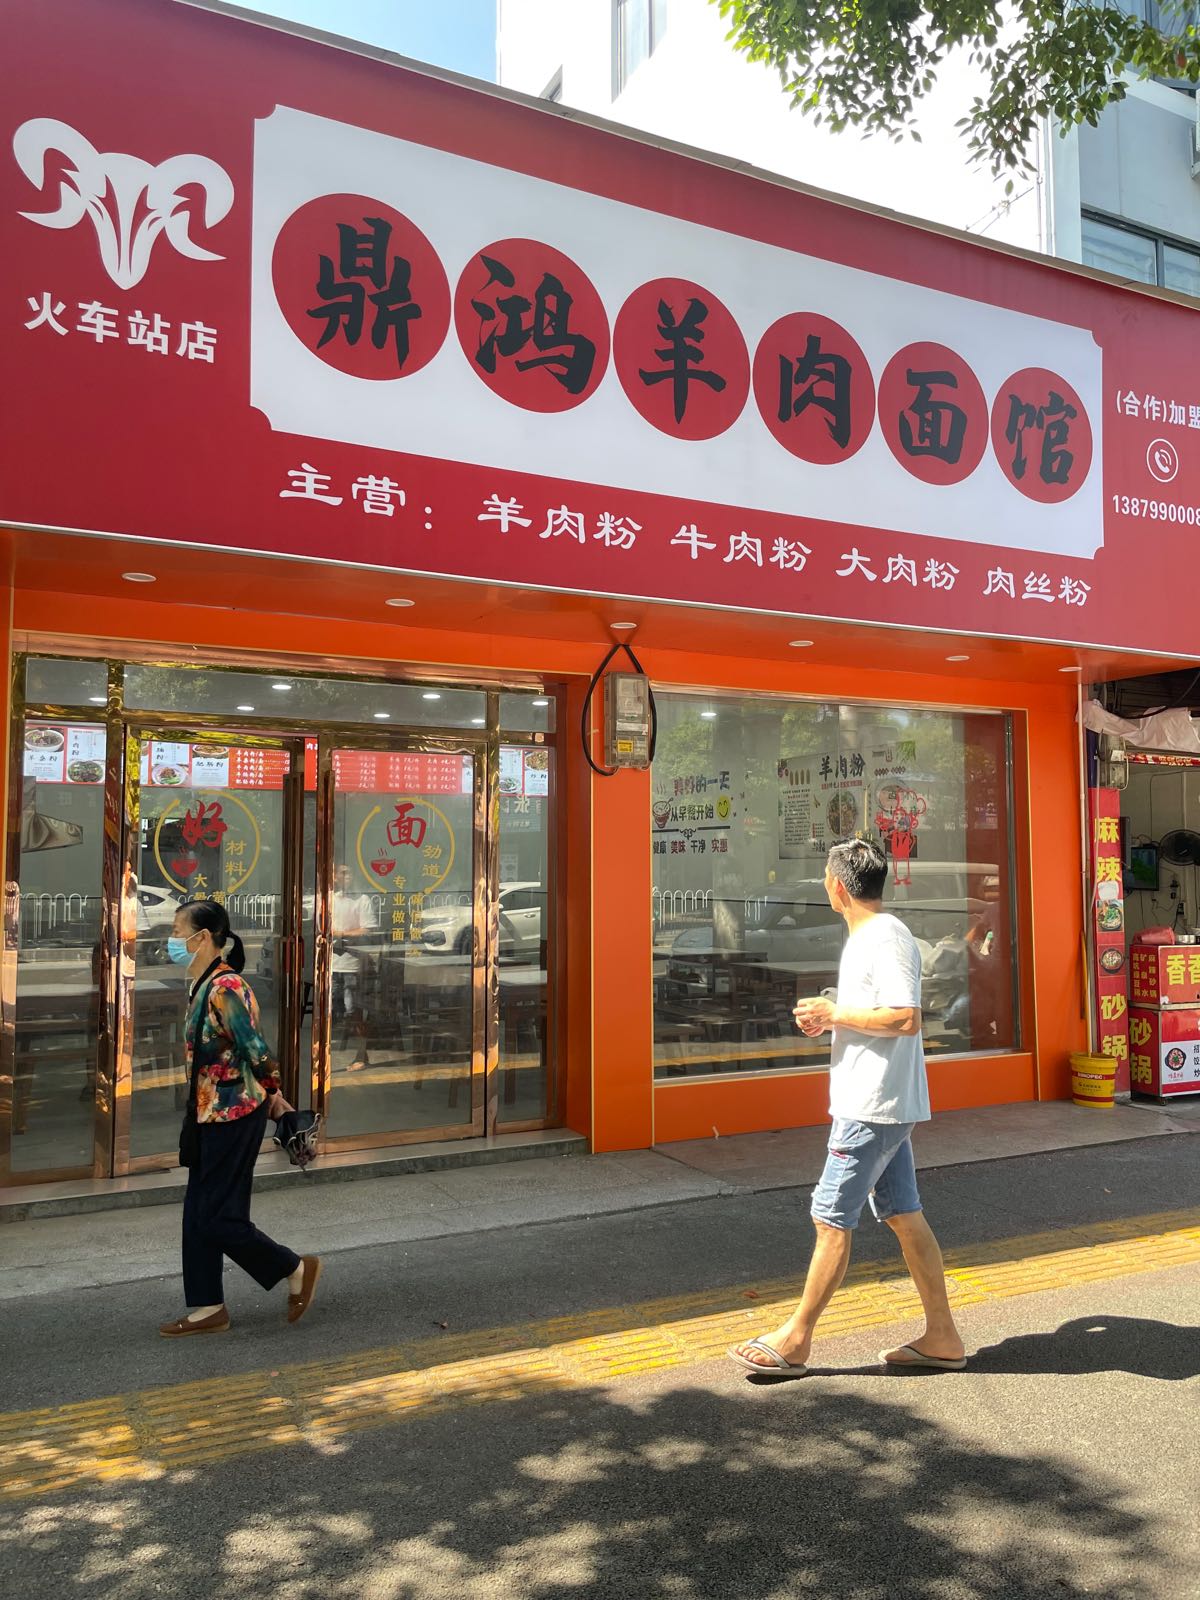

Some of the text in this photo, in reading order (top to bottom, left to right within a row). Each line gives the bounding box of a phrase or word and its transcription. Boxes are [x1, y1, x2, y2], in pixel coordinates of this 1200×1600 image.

[24, 292, 217, 364] 火车站店
[306, 217, 1077, 485] 鼎鸿羊肉面馆
[1116, 390, 1200, 430] (合作)加盟
[477, 493, 643, 550] 羊肉粉
[670, 524, 812, 573] 牛肉粉
[835, 547, 960, 591] 大肉粉
[982, 566, 1092, 607] 肉丝粉
[818, 753, 866, 782] 羊肉粉
[181, 799, 228, 848] 好
[386, 802, 427, 849] 面
[670, 803, 715, 822] 从早餐开始
[225, 839, 247, 877] 材料
[421, 845, 443, 879] 劲道
[670, 840, 686, 855] 美味
[690, 839, 706, 854] 干净
[711, 838, 729, 853] 实惠
[1094, 816, 1122, 884] 麻辣
[391, 875, 407, 942] 专业做面
[1100, 994, 1129, 1062] 砂锅
[1129, 1017, 1153, 1085] 砂锅
